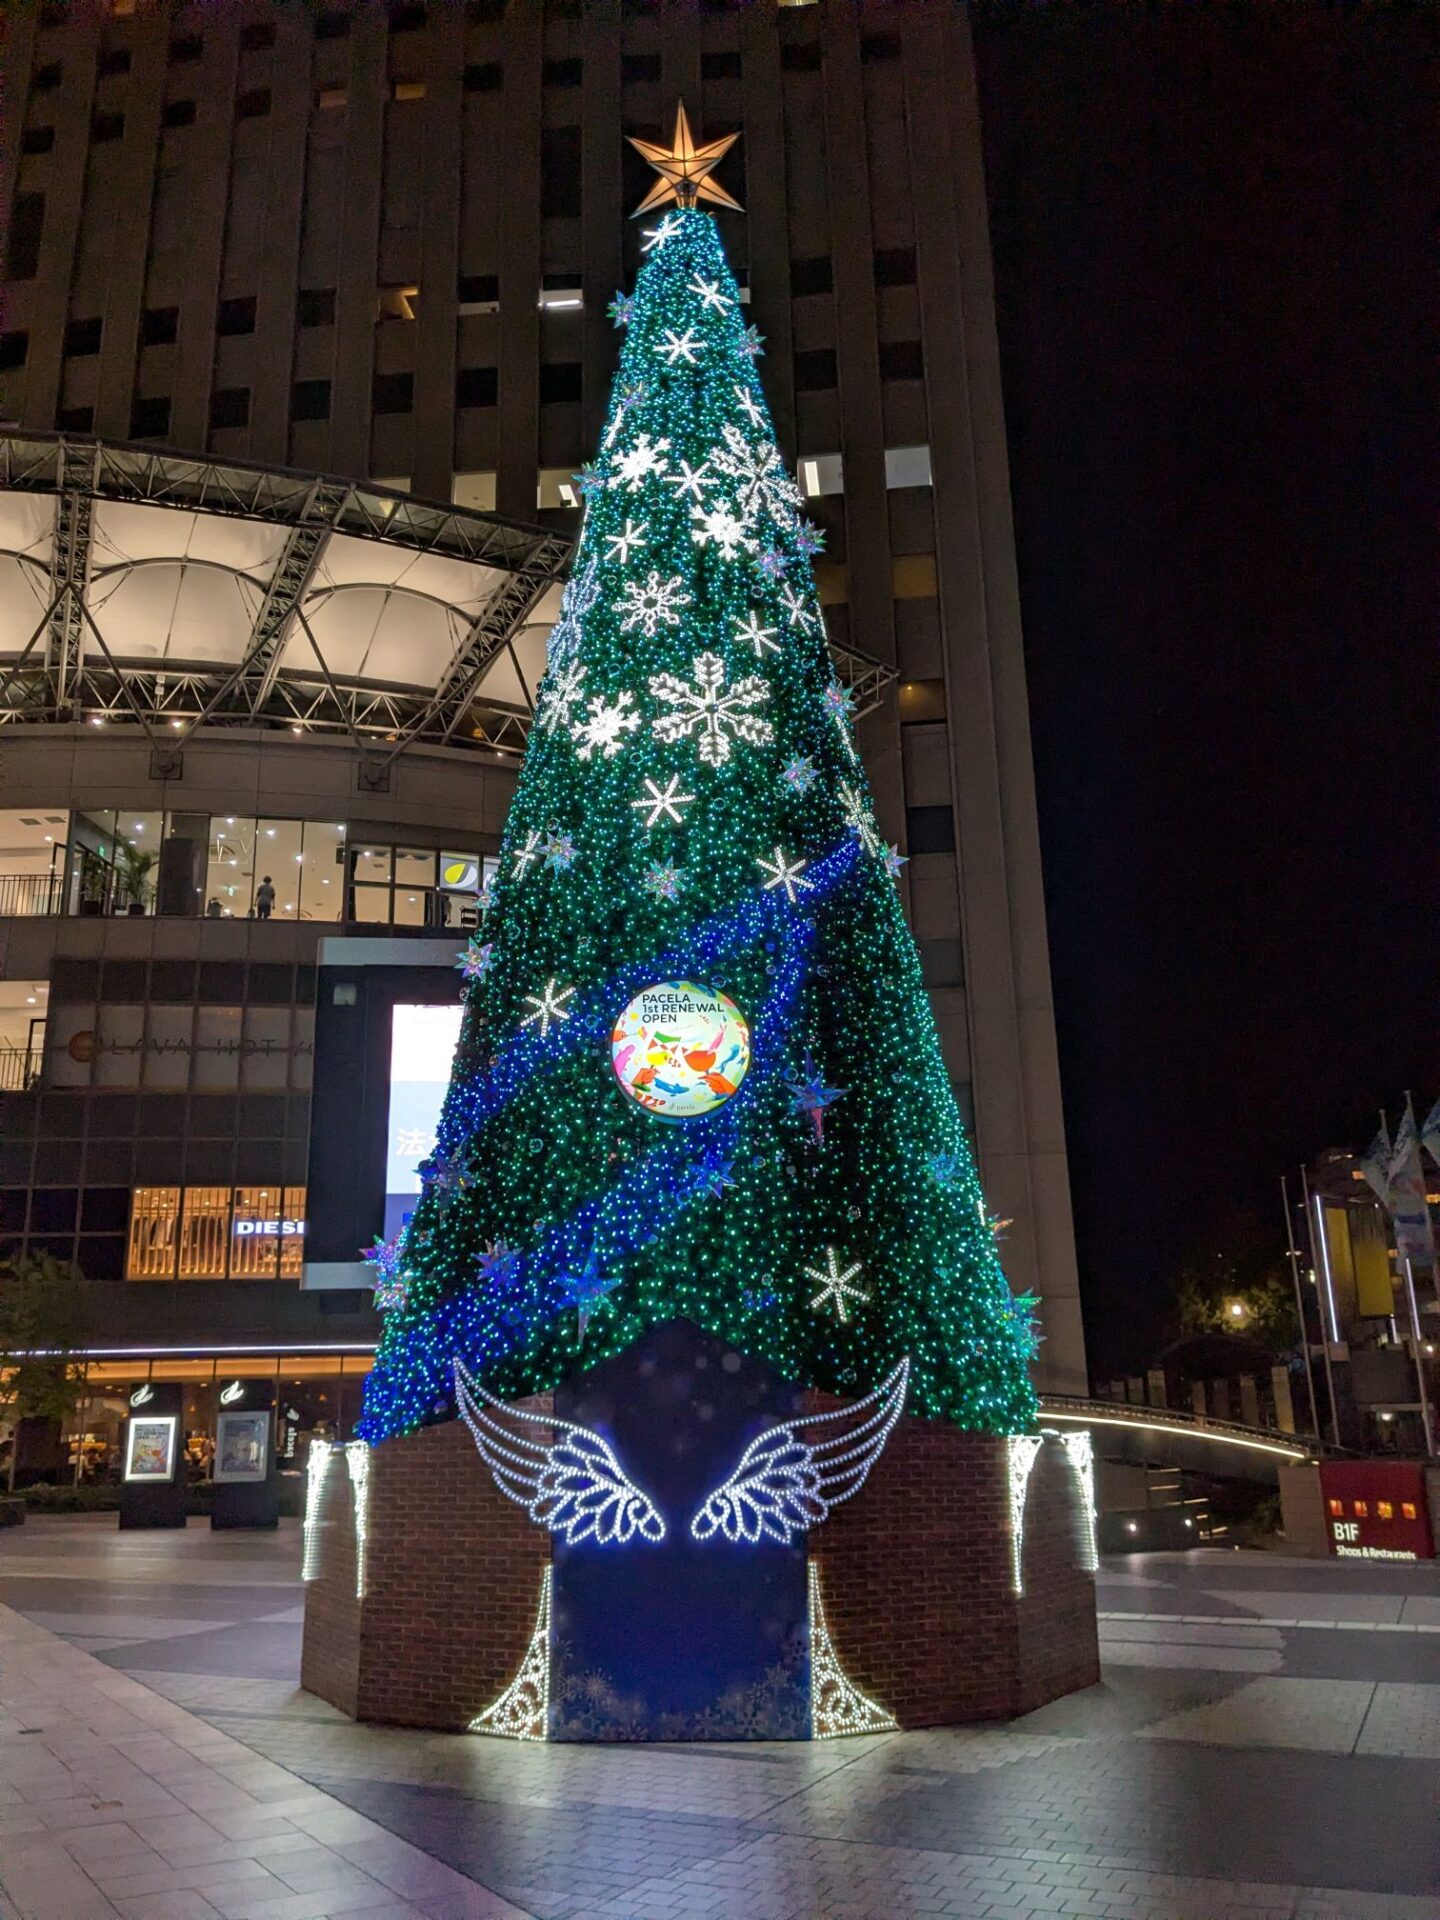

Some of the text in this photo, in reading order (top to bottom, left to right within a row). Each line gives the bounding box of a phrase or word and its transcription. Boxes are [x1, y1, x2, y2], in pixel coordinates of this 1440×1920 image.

[642, 994, 691, 1003] PACELA
[643, 1003, 725, 1013] 1st RENEWAL
[642, 1014, 677, 1023] OPEN
[112, 1038, 192, 1056] LAVA
[216, 1039, 275, 1057] HOT
[1333, 1522, 1360, 1542] B1F
[1336, 1545, 1417, 1560] Shops & Restaurants
